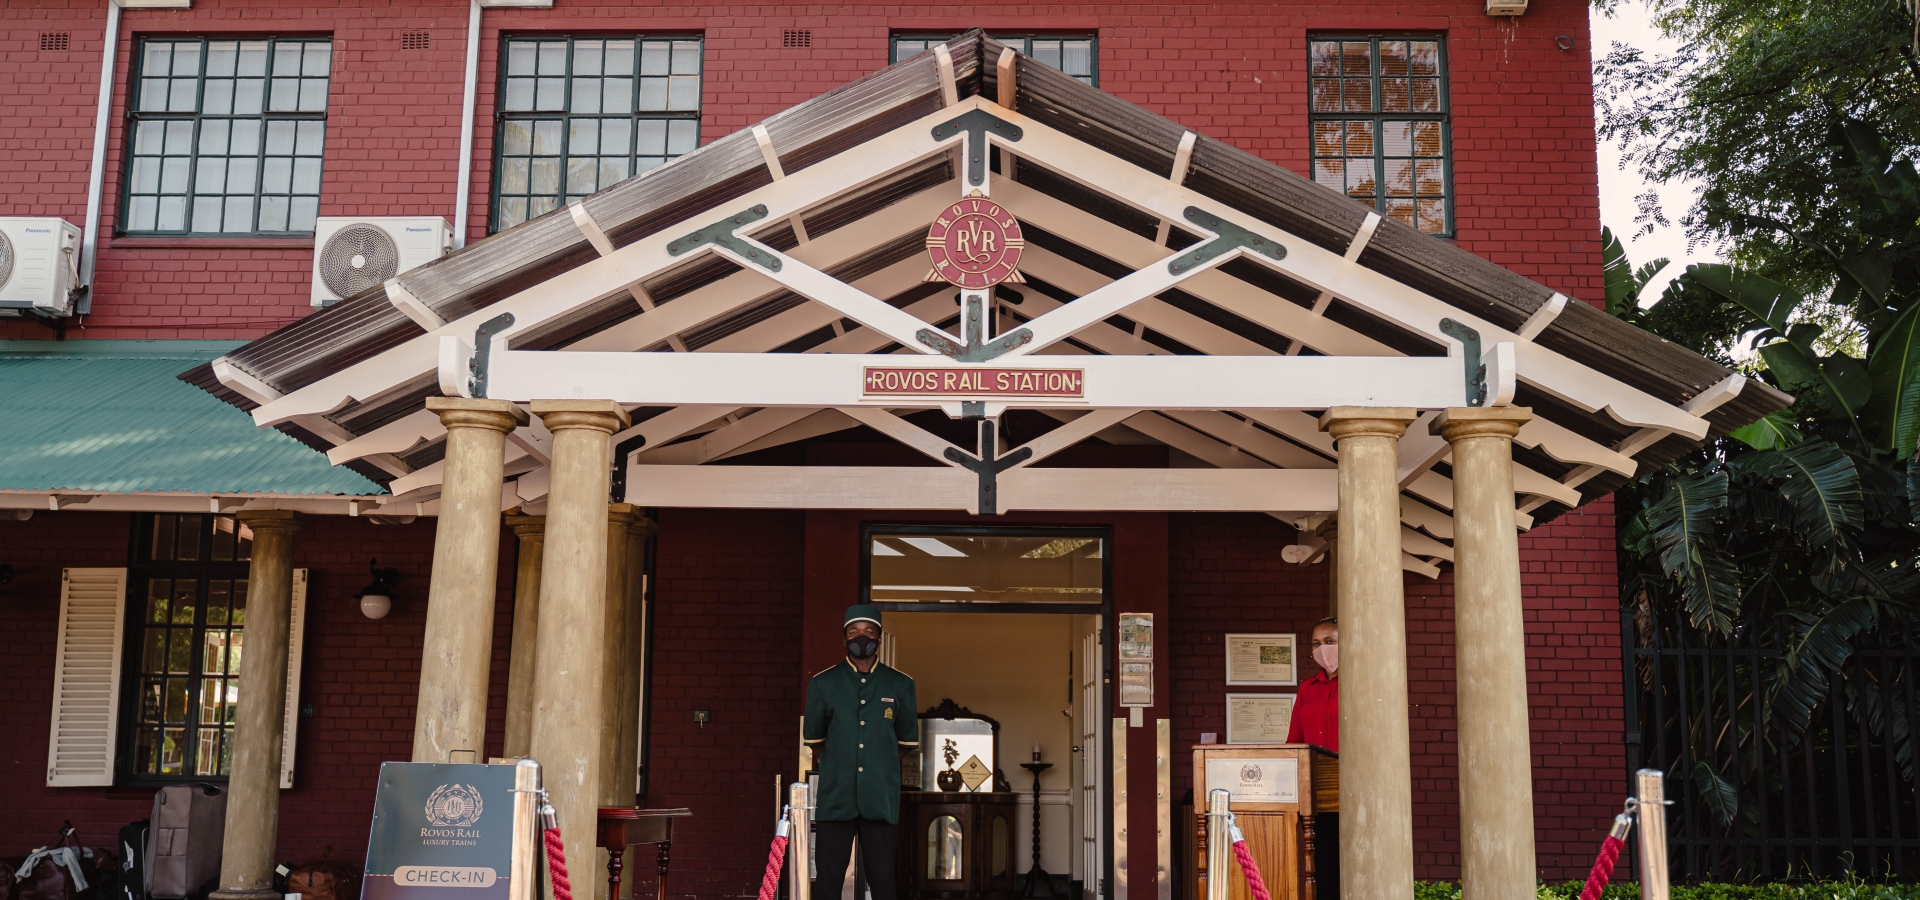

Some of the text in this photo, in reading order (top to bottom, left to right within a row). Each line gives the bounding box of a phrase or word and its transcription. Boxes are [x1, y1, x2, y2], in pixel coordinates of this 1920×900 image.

[937, 201, 1014, 228] ROVOS
[956, 221, 998, 264] RVR
[937, 259, 1013, 285] RAIL
[872, 371, 1075, 392] ROVOS RAIL STATION
[405, 869, 485, 883] CHECK-IN
